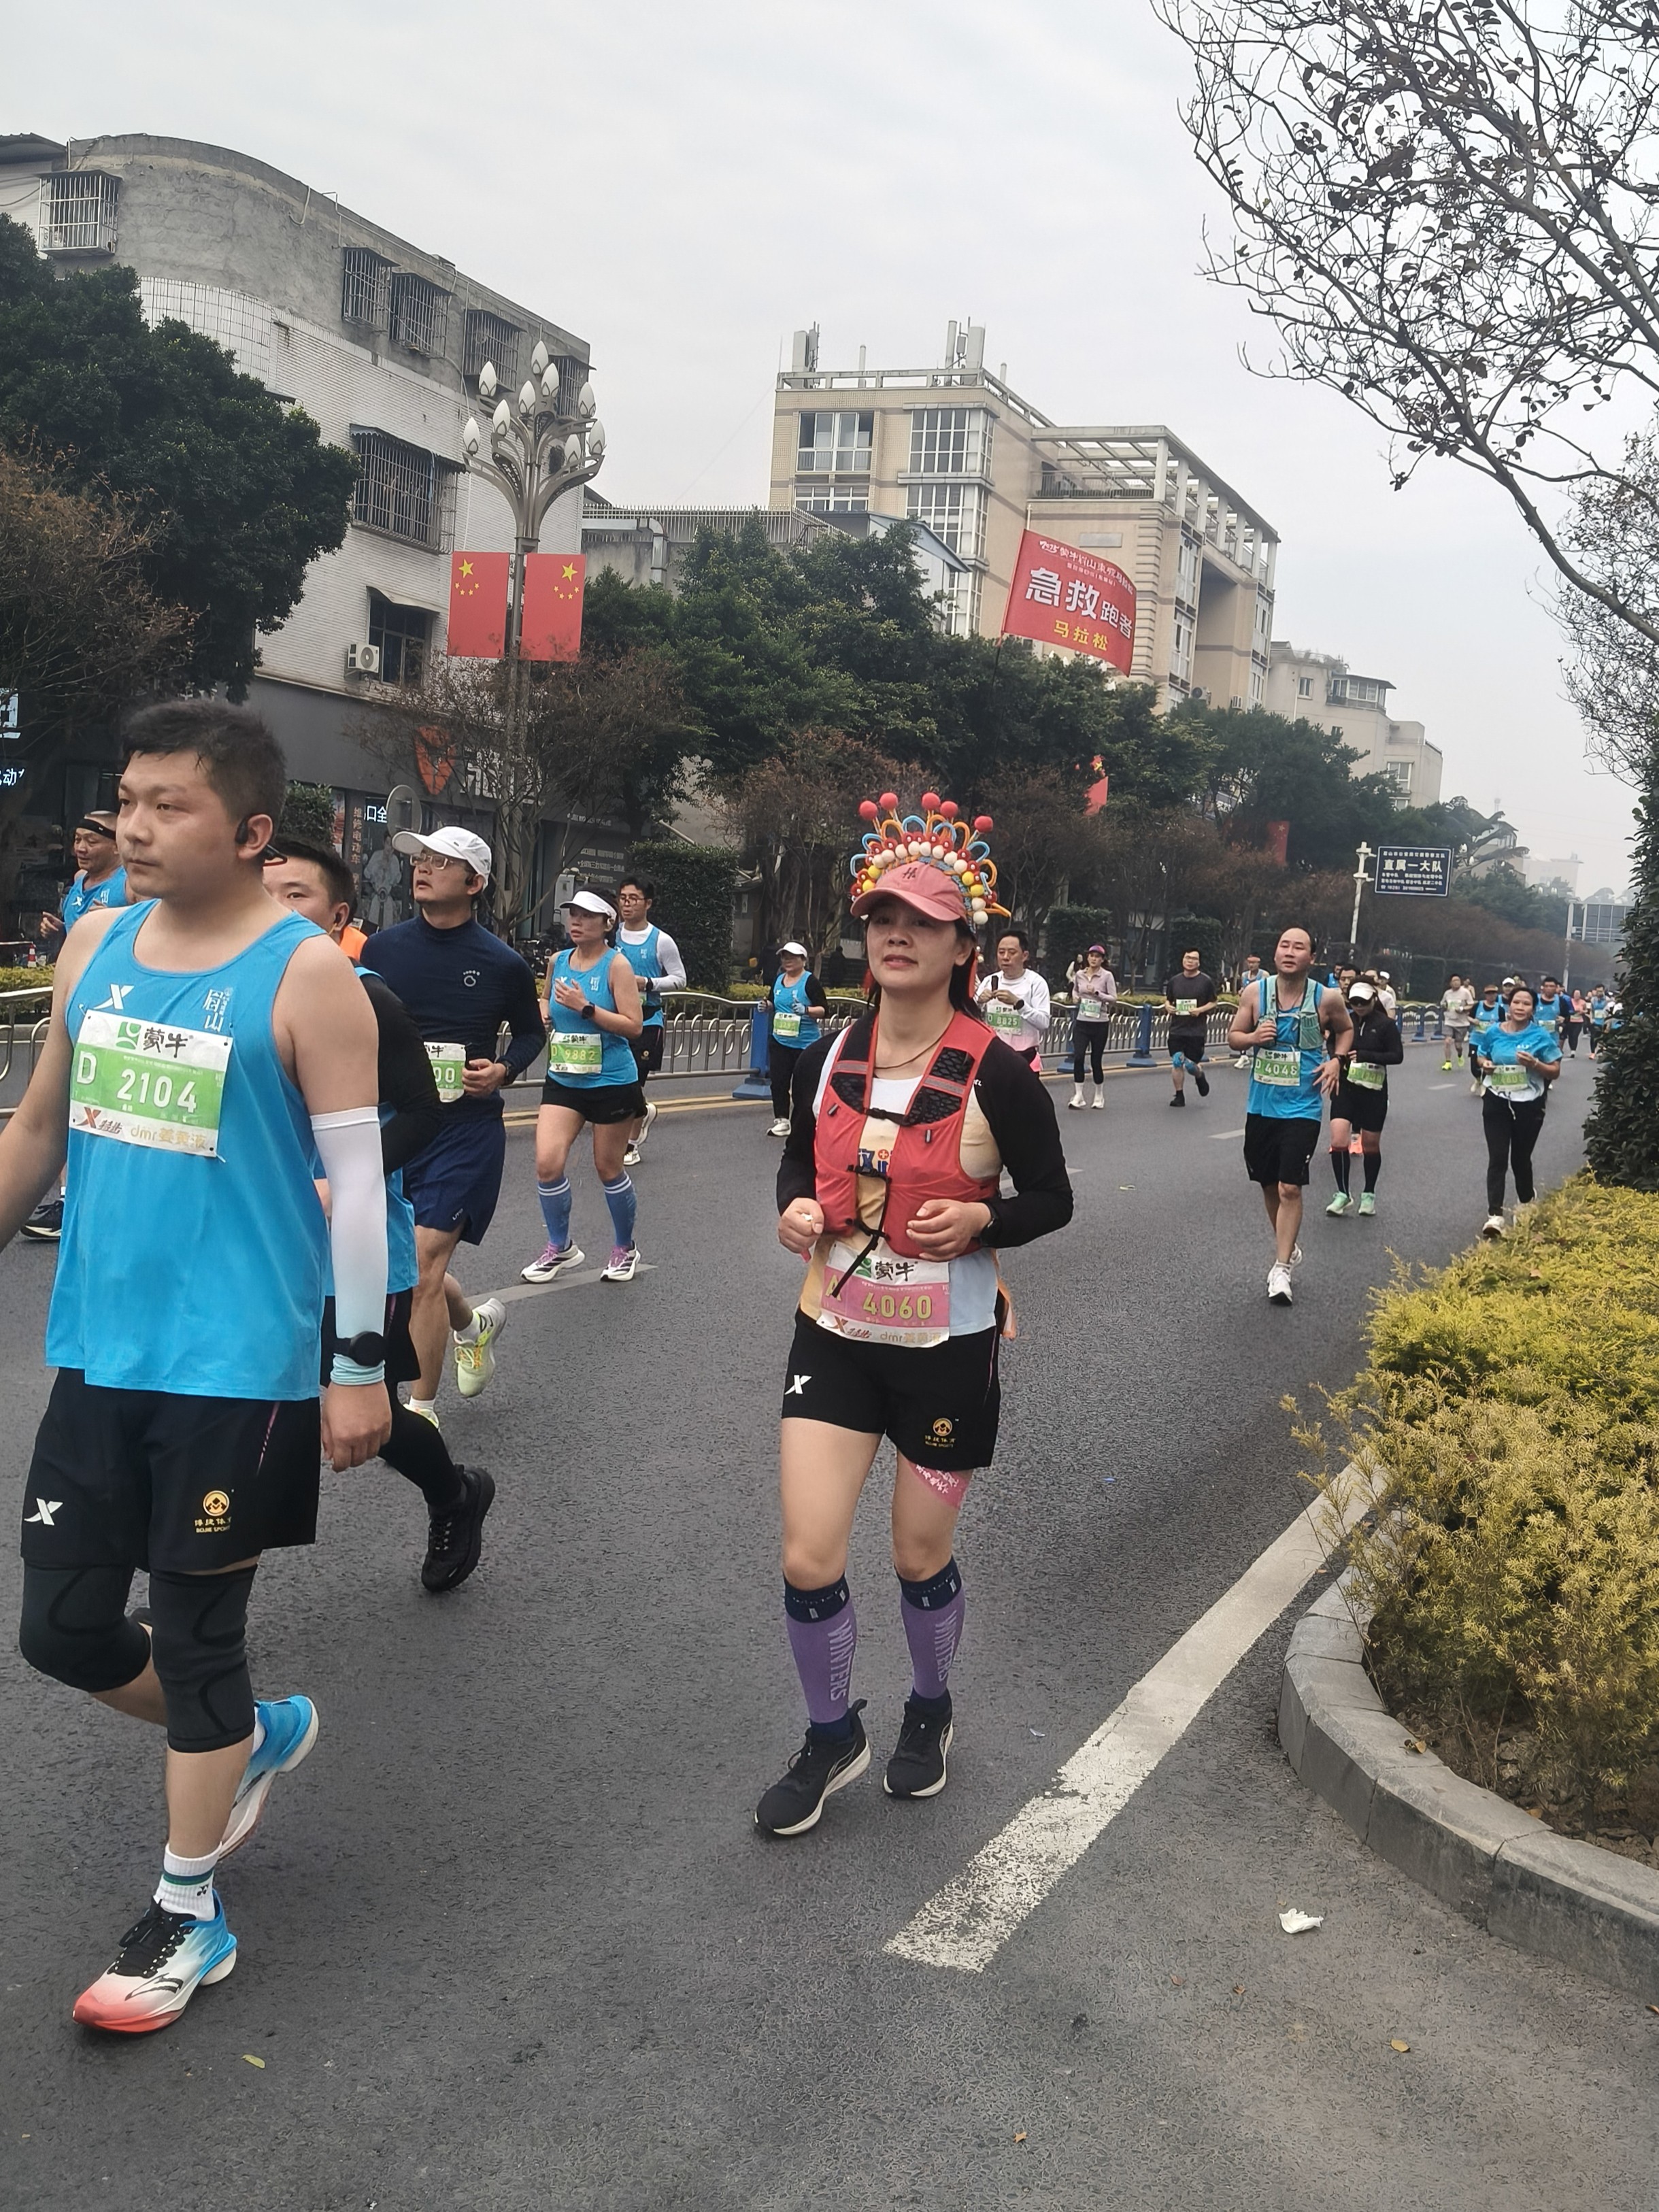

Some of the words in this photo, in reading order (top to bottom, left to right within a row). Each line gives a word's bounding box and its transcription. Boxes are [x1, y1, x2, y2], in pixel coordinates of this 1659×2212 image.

[1025, 567, 1133, 639] 急救跑者
[1054, 620, 1108, 651] 马拉松
[1384, 859, 1442, 872] 直属一大队
[996, 1016, 1018, 1026] 8825
[144, 1027, 188, 1058] 蒙牛
[426, 1045, 443, 1058] 牛
[565, 1049, 595, 1061] 9882
[76, 1050, 97, 1084] D
[117, 1069, 197, 1113] 2104
[875, 1260, 914, 1281] 蒙牛
[862, 1292, 932, 1320] 4060
[827, 1618, 855, 1701] WINTERS
